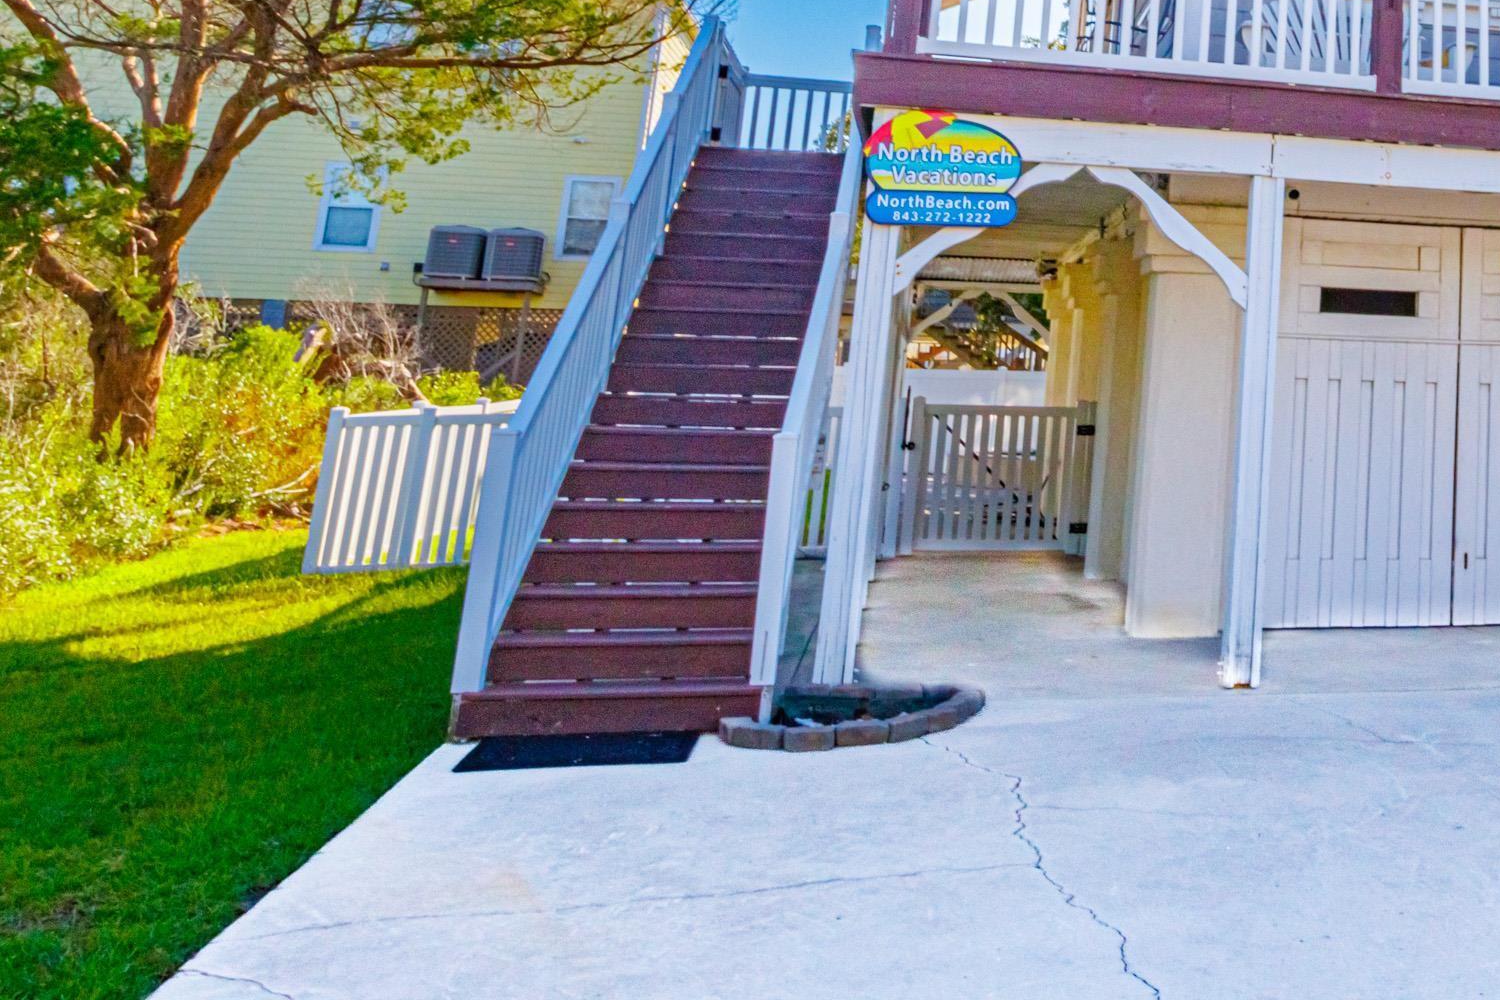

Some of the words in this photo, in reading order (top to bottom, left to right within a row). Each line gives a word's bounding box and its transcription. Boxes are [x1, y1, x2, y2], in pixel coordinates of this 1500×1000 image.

[877, 142, 943, 162] North
[949, 145, 1012, 165] Beach
[891, 165, 998, 186] Vacations
[877, 194, 1010, 210] NorthBeach.com
[892, 211, 991, 223] 843-272-1222
